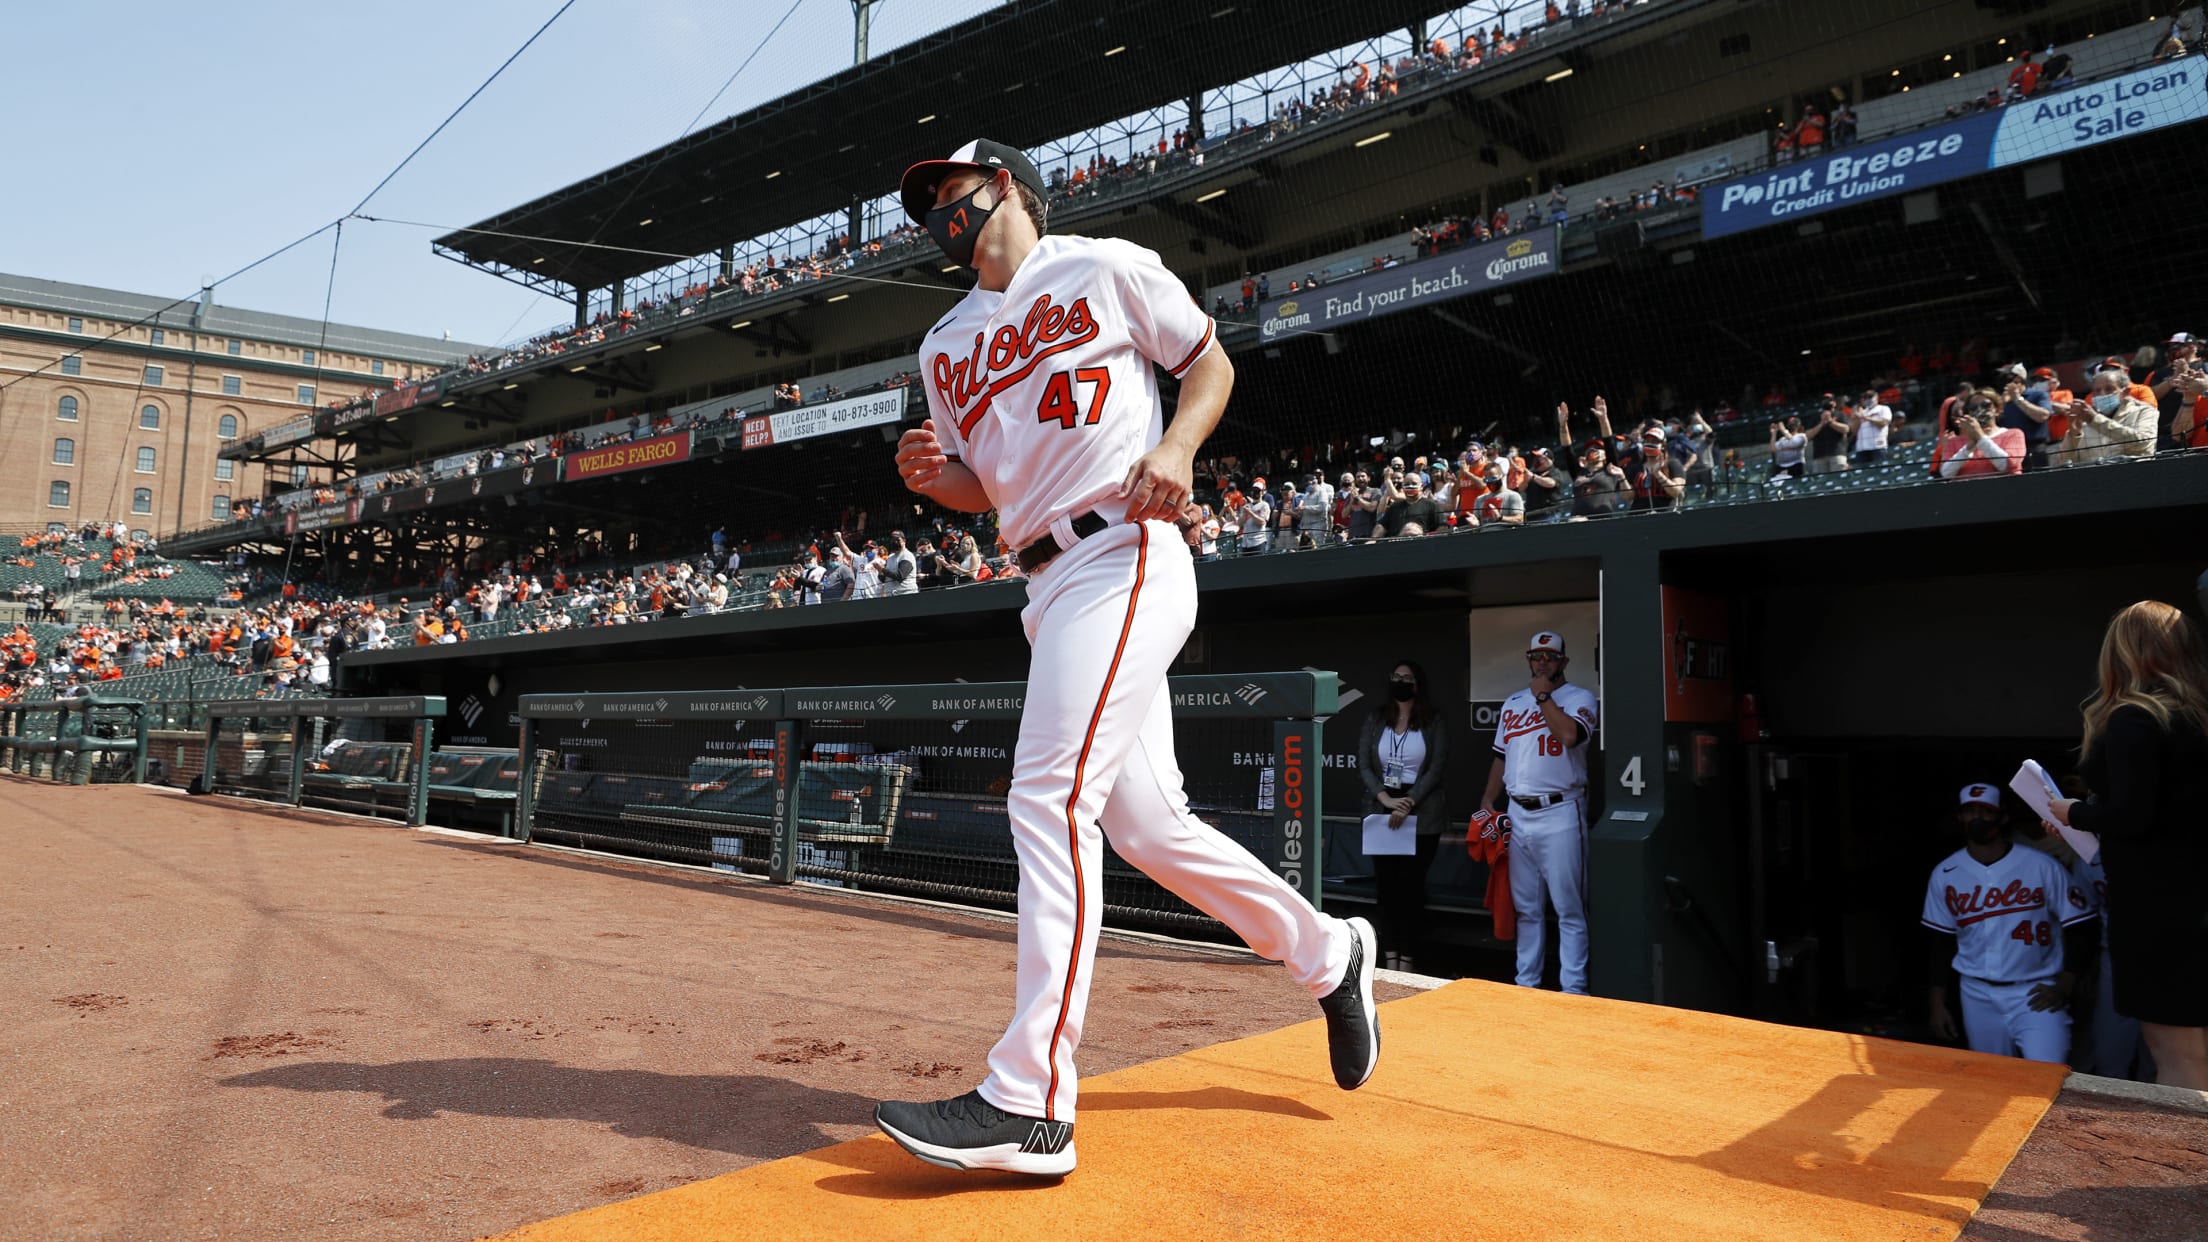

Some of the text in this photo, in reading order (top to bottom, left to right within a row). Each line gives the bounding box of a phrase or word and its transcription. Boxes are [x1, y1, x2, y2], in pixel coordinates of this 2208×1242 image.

[2032, 68, 2188, 125] Auto Loan
[2074, 107, 2146, 143] Sale
[1721, 132, 1964, 213] Point Breeze
[1771, 172, 1905, 217] Credit Union
[947, 207, 971, 240] 47
[1486, 251, 1549, 281] Corona
[1325, 267, 1469, 320] Find your beach.
[1263, 311, 1312, 338] Corona
[933, 294, 1100, 428] Orioles
[832, 398, 897, 423] 410-873-9900
[1038, 366, 1111, 430] 47
[745, 420, 765, 433] NEED
[773, 408, 827, 428] TEXT LOCATION
[778, 420, 826, 439] AND ISSUE TO
[745, 432, 769, 447] HELP?
[579, 441, 677, 473] WELLS FARGO
[604, 703, 655, 712] BANK OF AMERICA
[690, 702, 752, 711] BANK OF AMERICA
[797, 701, 875, 711] BANK OF AMERICA
[932, 698, 1023, 710] BANK OF AMERIC
[1171, 692, 1232, 706] MERICA
[1476, 707, 1500, 724] Or
[705, 741, 749, 751] BANK OF AM
[910, 746, 1006, 758] BANK OF AMERICA
[1538, 734, 1563, 757] 18
[408, 725, 423, 817] Orioles.com
[1233, 752, 1357, 768] BANK MER
[1620, 756, 1646, 796] 4
[771, 730, 788, 871] Orioles.com
[1279, 735, 1303, 889] oles.com
[1945, 879, 2046, 917] Orioles
[2011, 919, 2052, 946] 48
[1020, 1122, 1068, 1155] N
